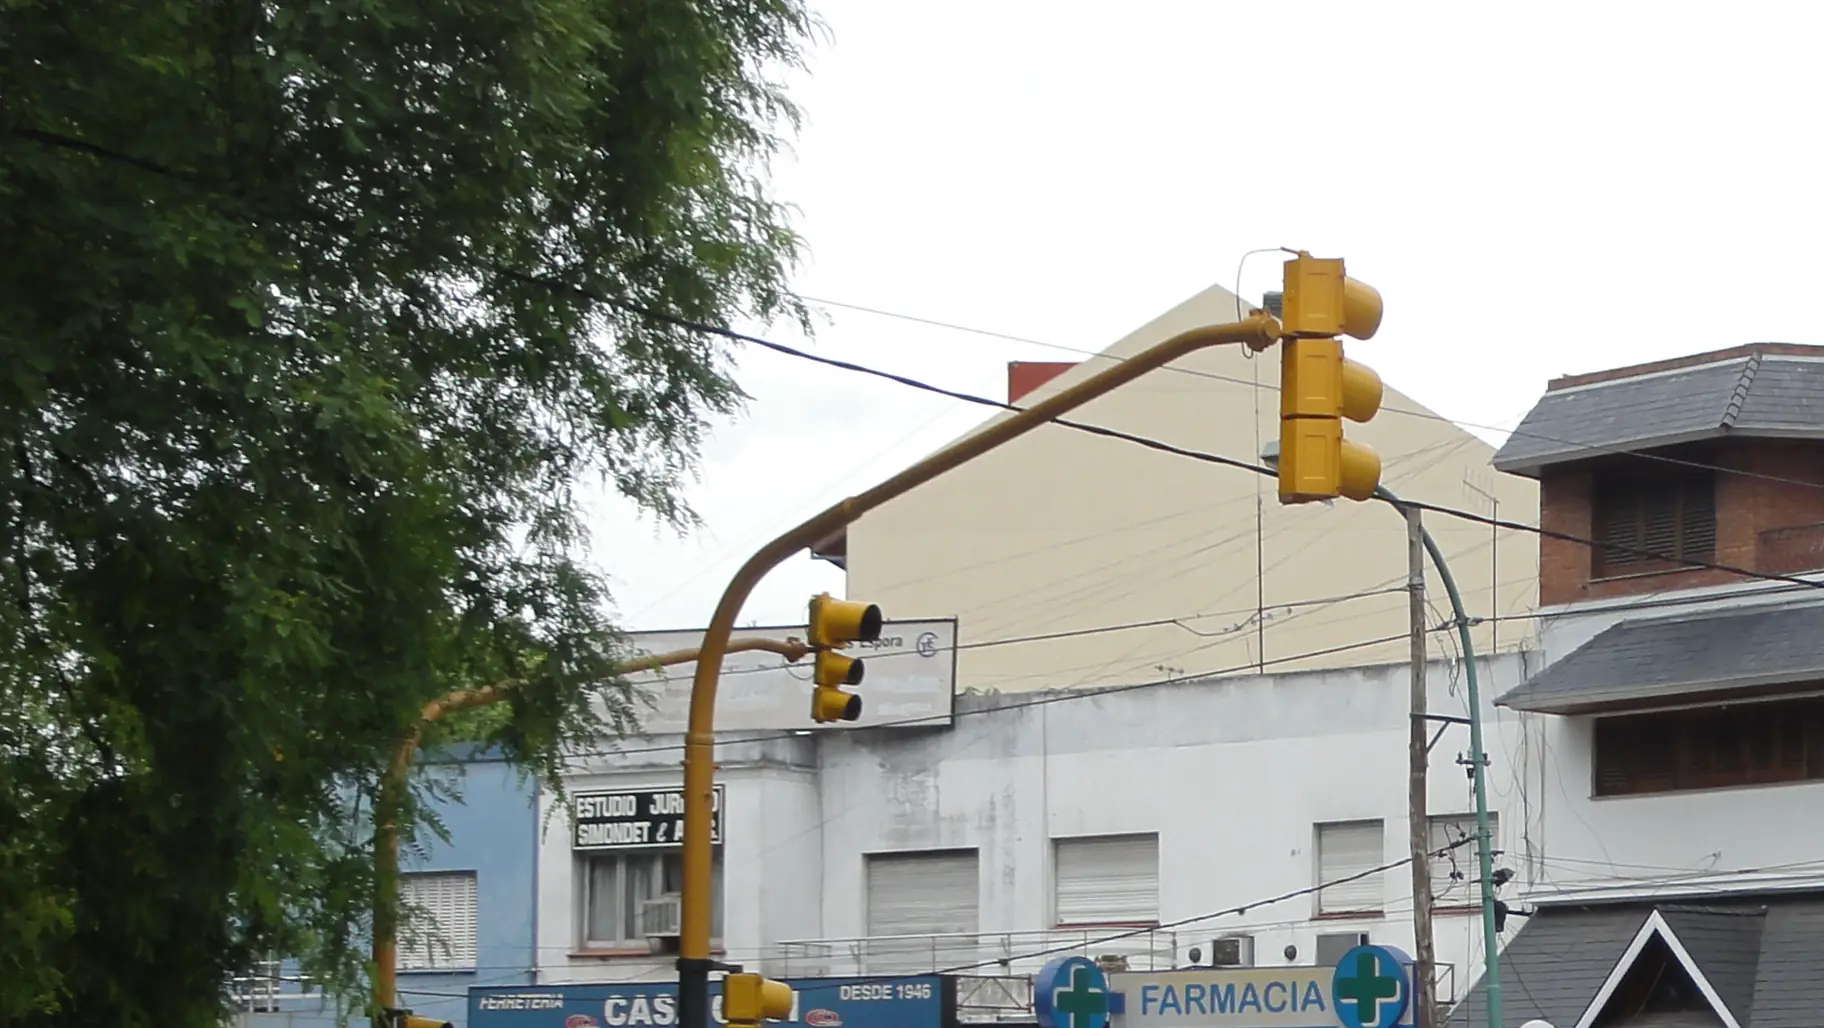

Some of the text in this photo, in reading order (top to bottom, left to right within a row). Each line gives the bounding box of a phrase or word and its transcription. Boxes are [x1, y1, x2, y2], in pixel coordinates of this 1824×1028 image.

[576, 795, 637, 818] ESTUDIO
[578, 821, 651, 845] SIMONDET
[840, 983, 932, 1001] DESDE 1946
[1140, 980, 1327, 1016] FARMACIA
[604, 993, 680, 1027] CAS
